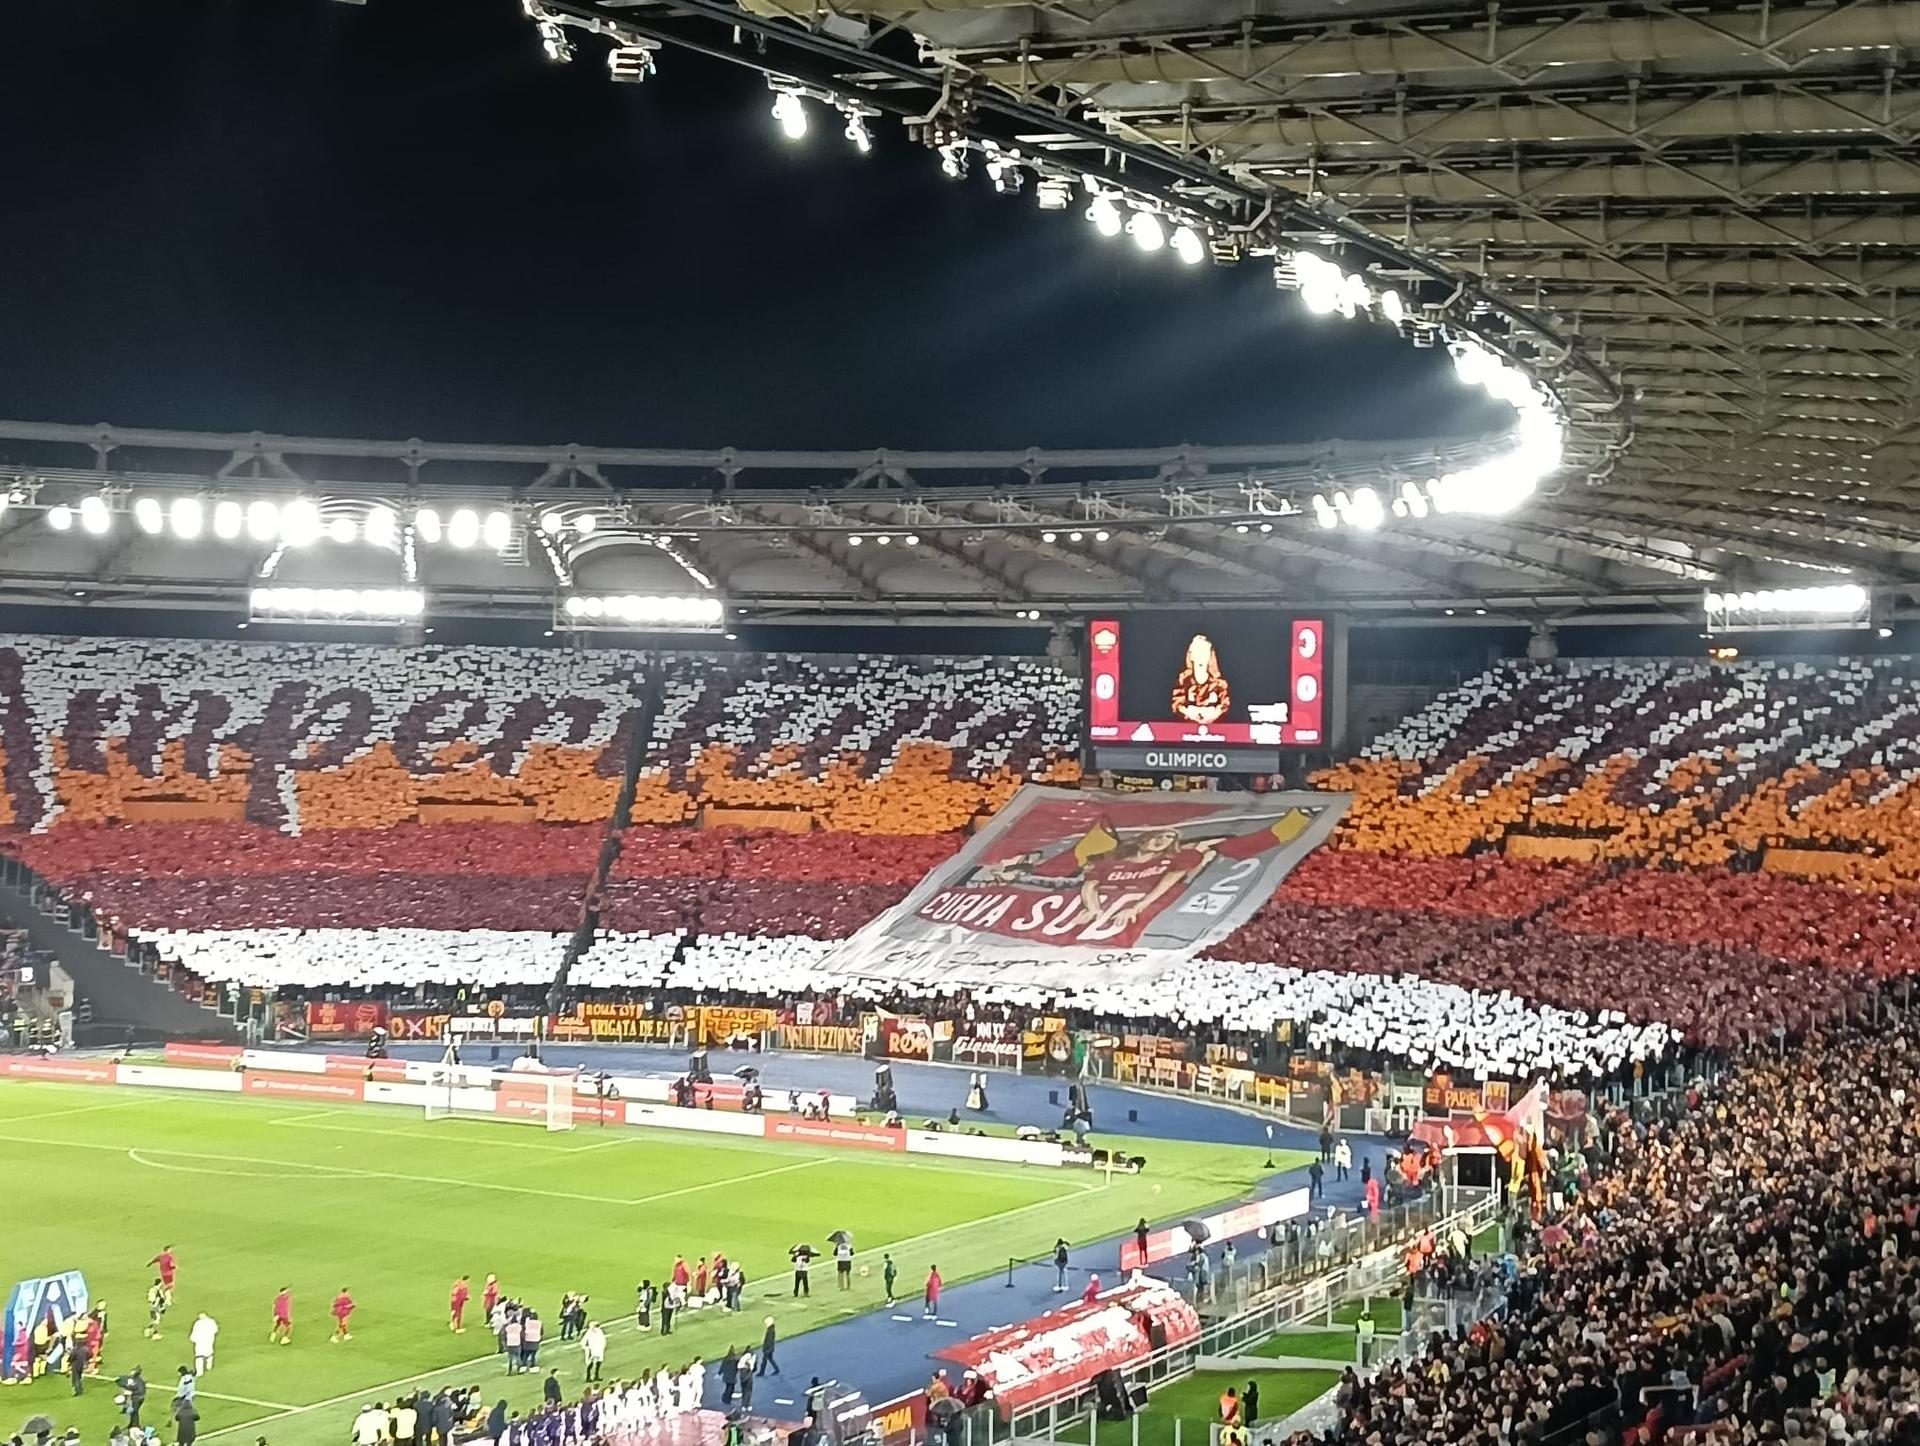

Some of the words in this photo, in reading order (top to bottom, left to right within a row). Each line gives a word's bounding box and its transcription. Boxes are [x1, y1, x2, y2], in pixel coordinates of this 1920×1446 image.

[1096, 674, 1115, 700] 0
[1297, 675, 1318, 702] 0
[1146, 752, 1227, 768] OLIMPICO
[1108, 864, 1169, 881] Barilla
[920, 892, 1018, 927] CURVA
[1012, 892, 1147, 941] SUD
[590, 1019, 637, 1036] BRIGATA
[639, 1020, 654, 1037] DE
